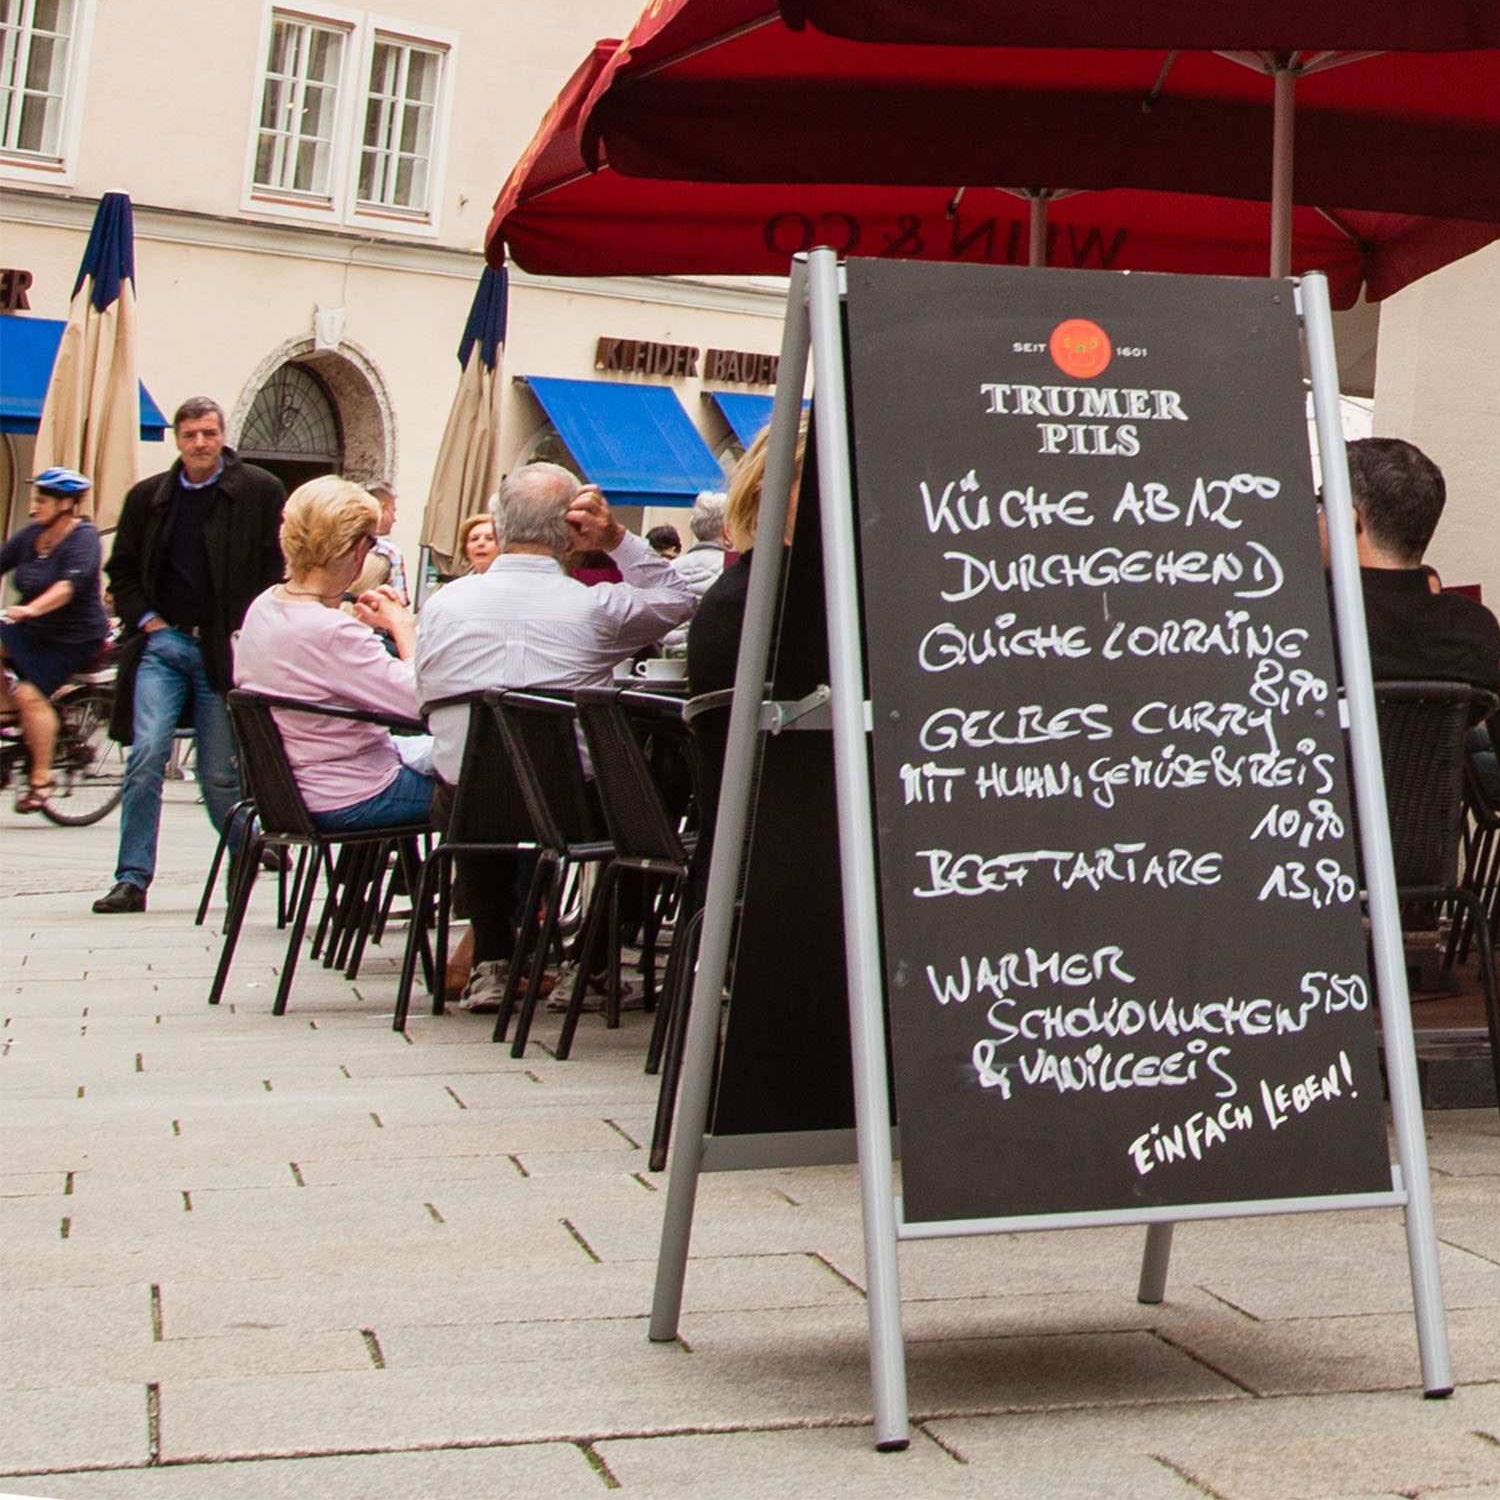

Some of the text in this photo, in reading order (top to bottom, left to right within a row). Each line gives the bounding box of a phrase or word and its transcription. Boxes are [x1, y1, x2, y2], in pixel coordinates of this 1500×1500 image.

[600, 337, 700, 378] KLEIDER
[1012, 342, 1147, 357] SEIT 1601
[980, 383, 1189, 421] TRUMER
[1037, 423, 1141, 457] PILS
[920, 469, 1095, 534] KÜCHE
[1113, 482, 1180, 525] AB
[940, 541, 1284, 602] DURCHGEHEND
[1249, 658, 1328, 715] 8,90
[919, 701, 1280, 755] GELBES CURRY
[1250, 799, 1345, 848] 10,90
[1257, 858, 1356, 909] 13,90
[926, 945, 1136, 1006] WARMER
[972, 1039, 1012, 1100] &
